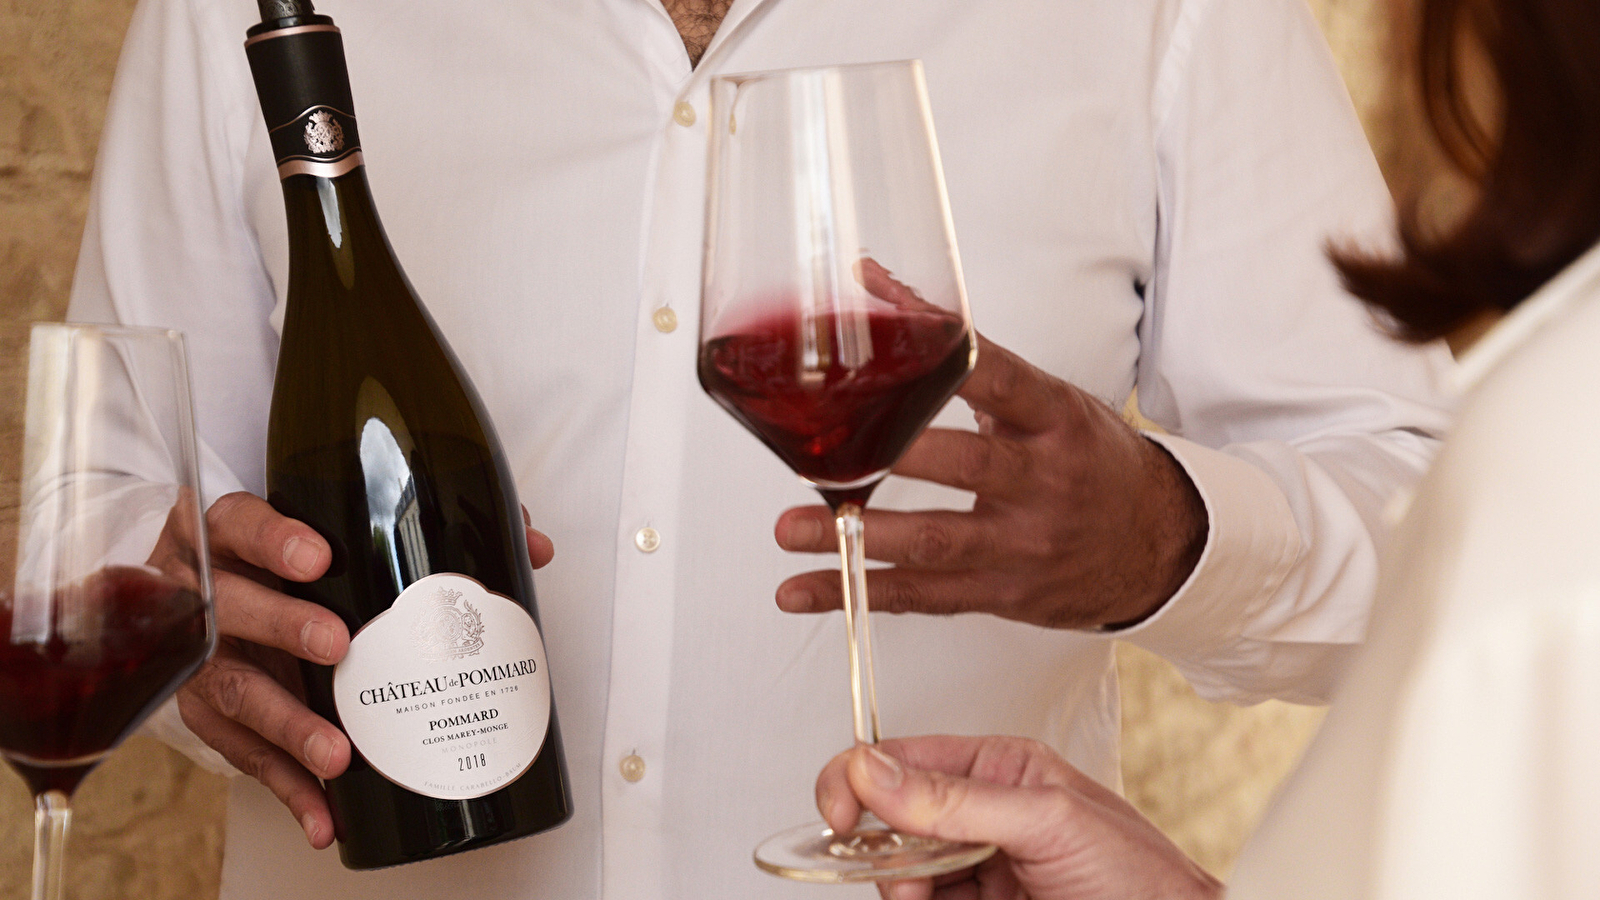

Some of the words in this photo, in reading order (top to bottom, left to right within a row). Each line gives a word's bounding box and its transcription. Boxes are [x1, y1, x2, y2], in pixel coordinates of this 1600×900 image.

[359, 675, 448, 706] CHÂTEAU
[449, 678, 459, 687] de
[458, 658, 537, 688] POMMARD
[396, 702, 436, 714] MAISON
[485, 689, 496, 697] EN
[501, 685, 519, 695] 1726
[429, 708, 499, 731] POMMARD
[422, 736, 445, 745] CLOS
[448, 723, 509, 741] MAREY-MONGE
[441, 736, 498, 754] MONOPOLE
[458, 753, 486, 771] 2018
